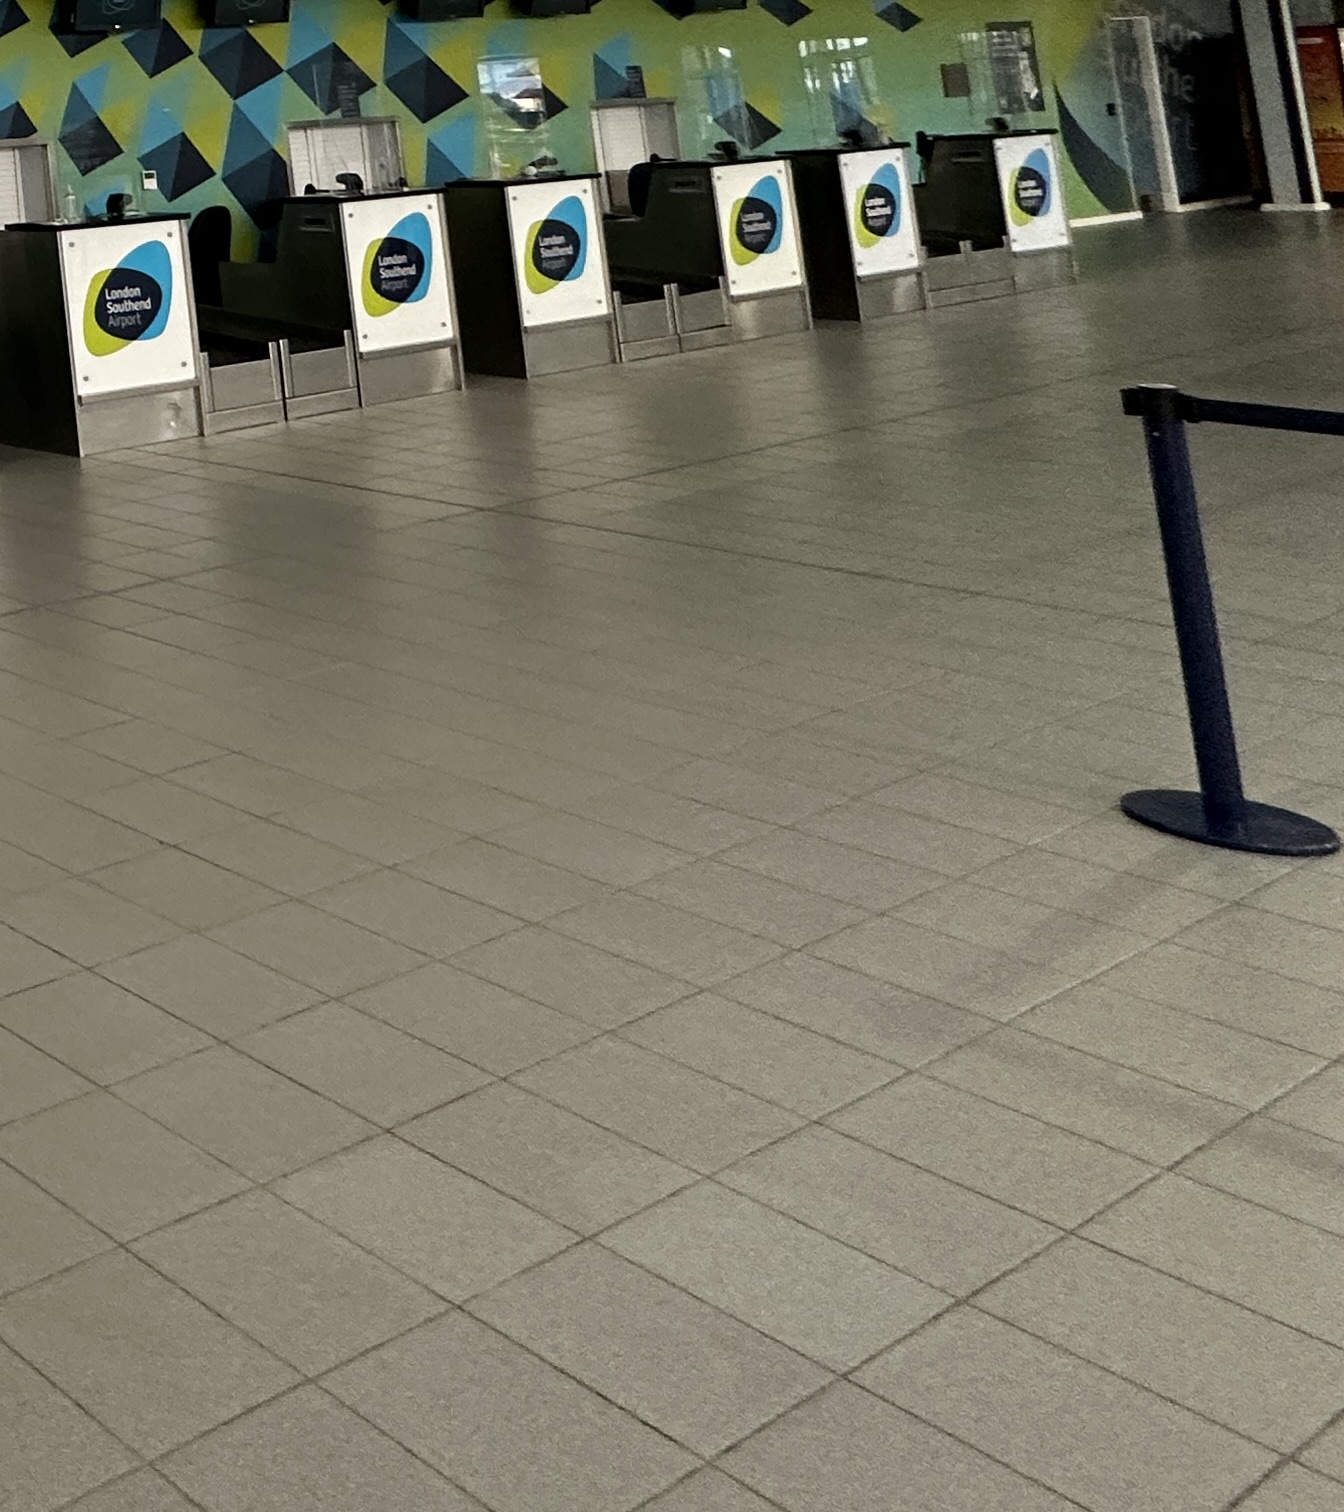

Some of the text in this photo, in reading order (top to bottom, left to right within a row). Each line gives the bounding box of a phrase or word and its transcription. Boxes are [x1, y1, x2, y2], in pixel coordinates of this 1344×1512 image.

[104, 286, 142, 300] London
[105, 297, 152, 314] Southend
[107, 313, 143, 329] Airport
